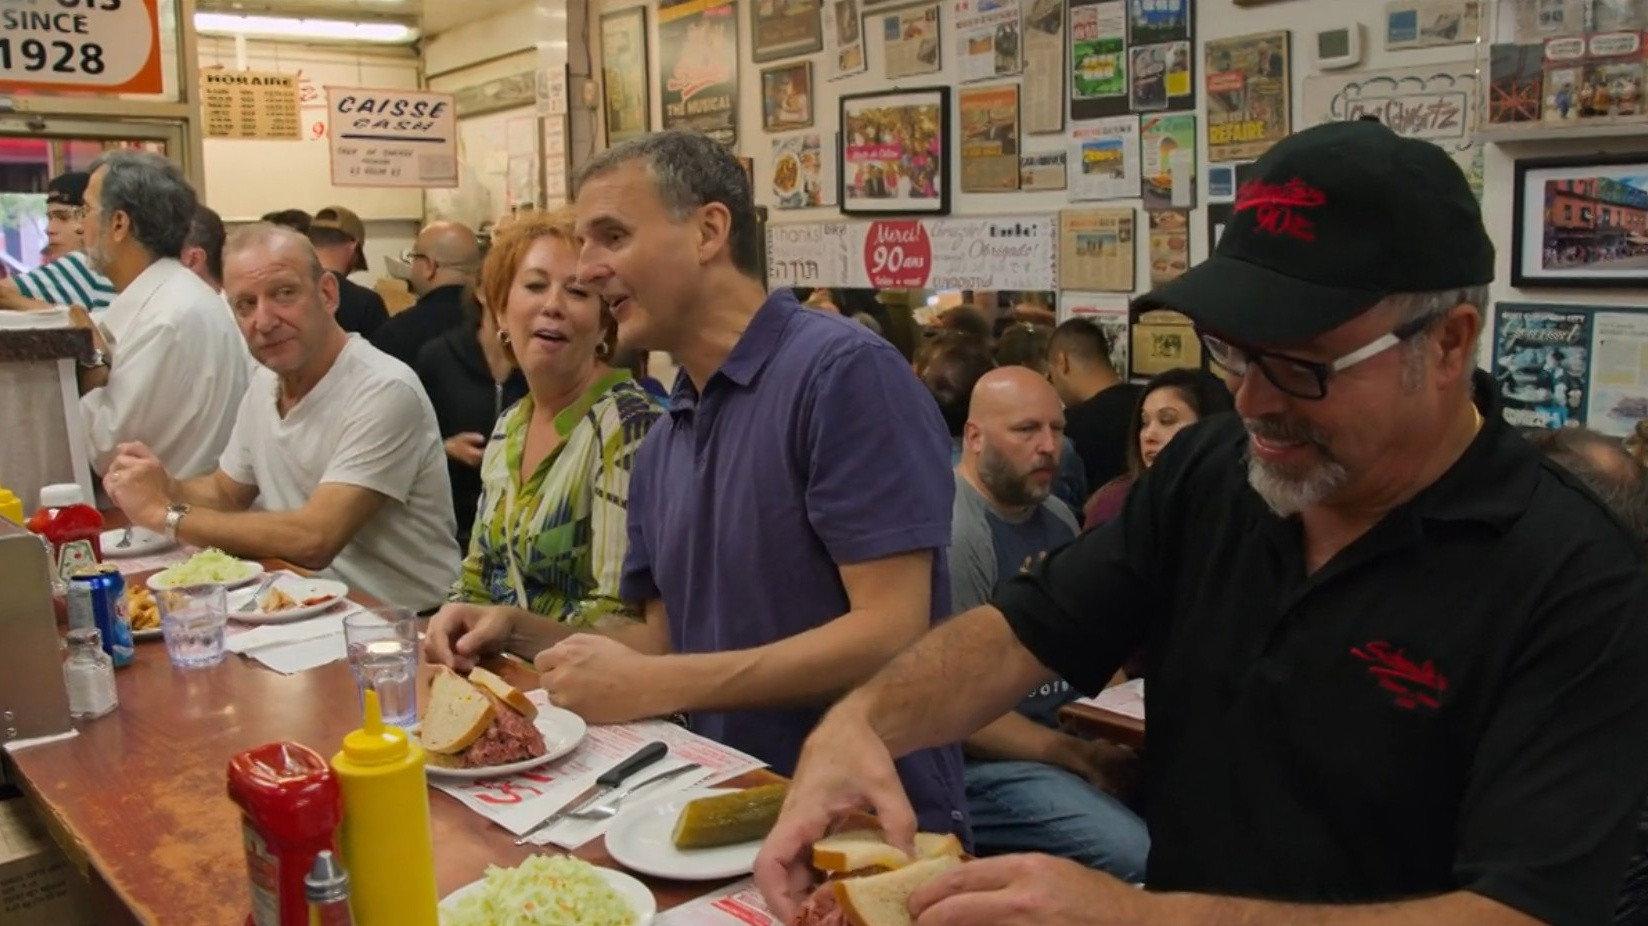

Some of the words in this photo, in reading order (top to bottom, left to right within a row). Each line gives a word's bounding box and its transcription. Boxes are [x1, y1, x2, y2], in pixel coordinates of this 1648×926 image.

[3, 9, 89, 34] SINCE
[0, 38, 105, 75] 1928
[338, 97, 447, 118] CAISSE
[352, 119, 435, 132] CASH
[871, 246, 903, 273] 90
[902, 257, 924, 268] ans
